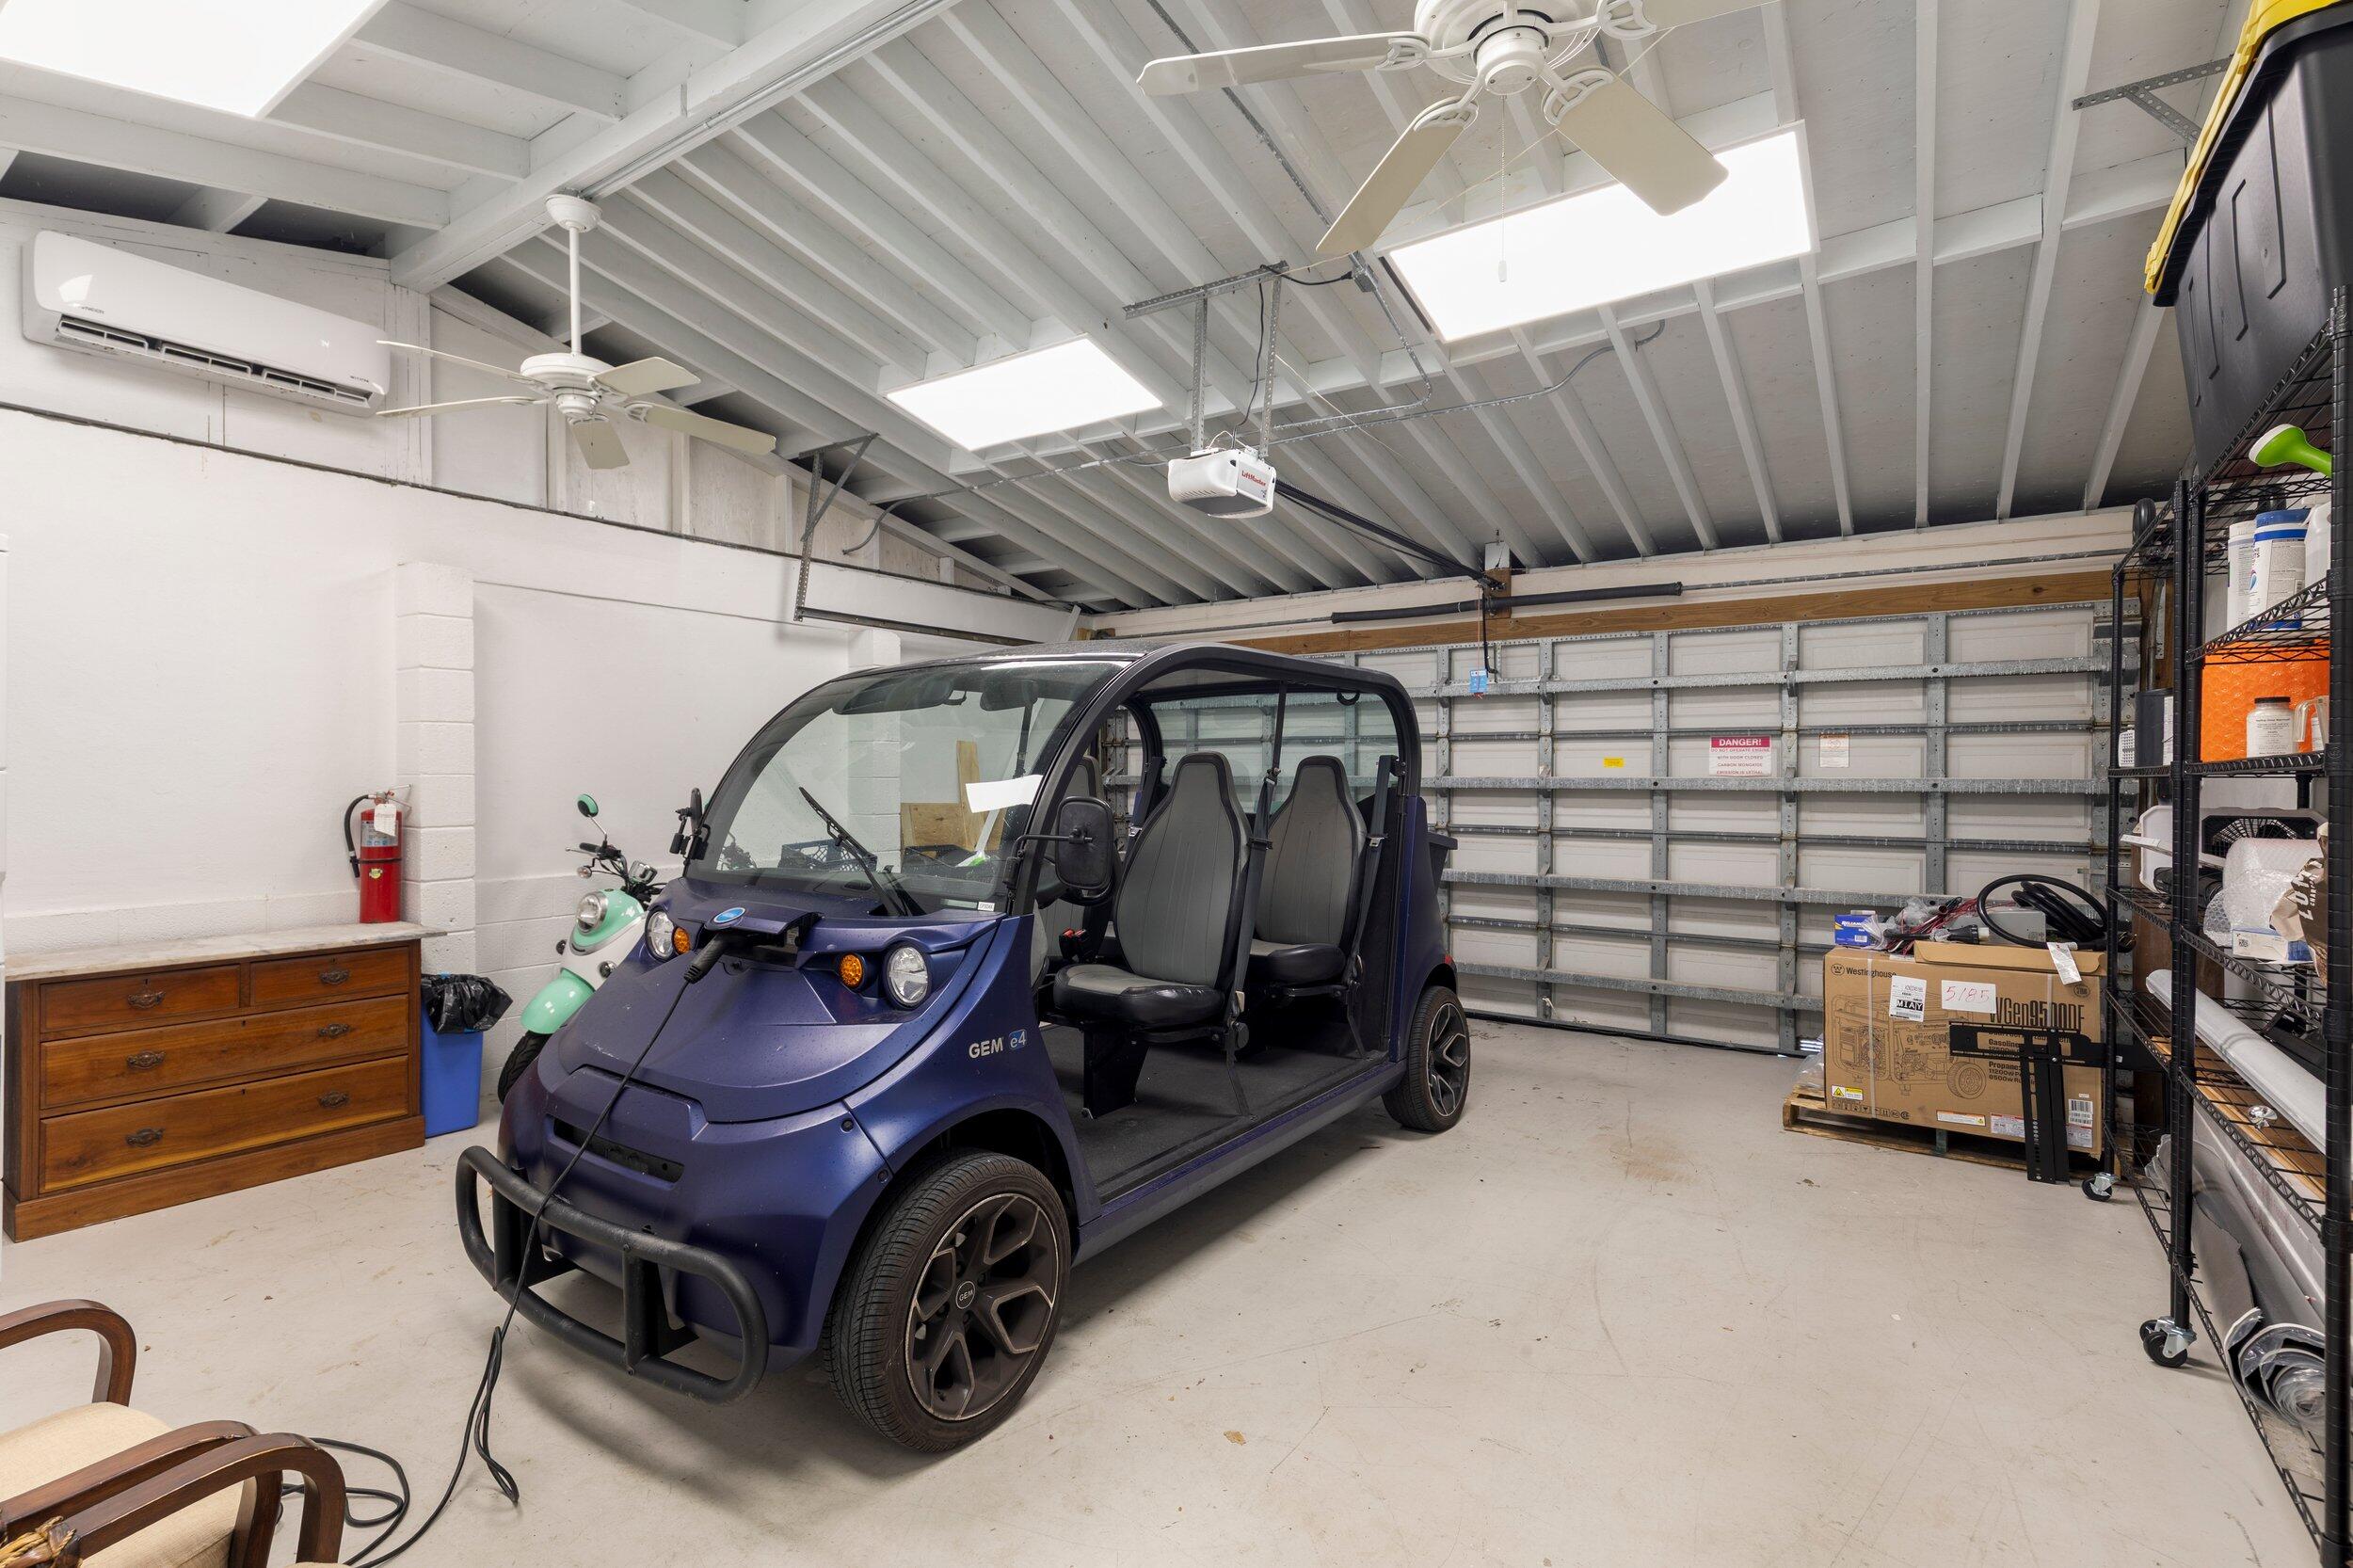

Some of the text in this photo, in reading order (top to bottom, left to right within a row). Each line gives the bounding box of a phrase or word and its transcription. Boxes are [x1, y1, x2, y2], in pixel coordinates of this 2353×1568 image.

[1241, 471, 1266, 487] LiftMaster
[1719, 738, 1762, 746] DANGER!
[968, 1031, 1027, 1059] GEM e4
[959, 1289, 973, 1302] GEM
